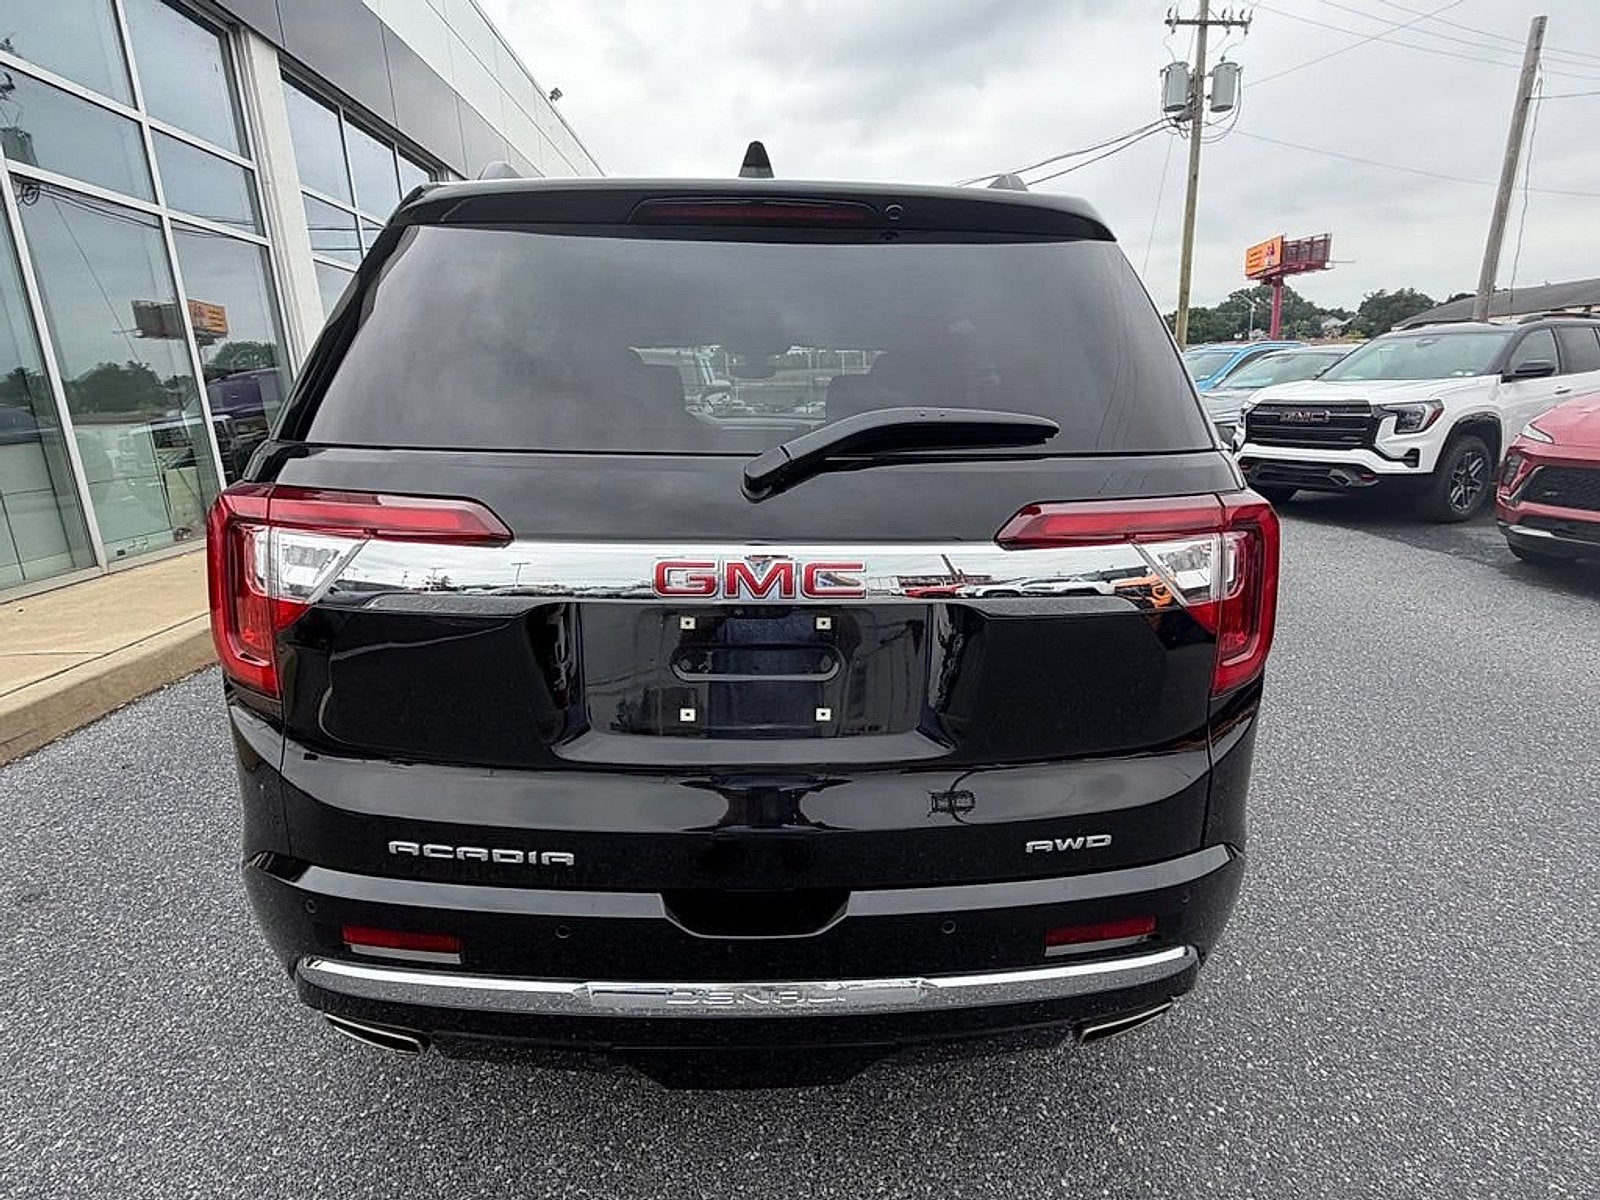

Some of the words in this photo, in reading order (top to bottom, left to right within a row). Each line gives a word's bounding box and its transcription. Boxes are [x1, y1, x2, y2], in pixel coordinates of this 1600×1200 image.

[653, 559, 866, 599] GMC
[388, 841, 575, 866] ACADIA
[1025, 834, 1112, 853] AWD
[665, 990, 846, 1005] DENALI
